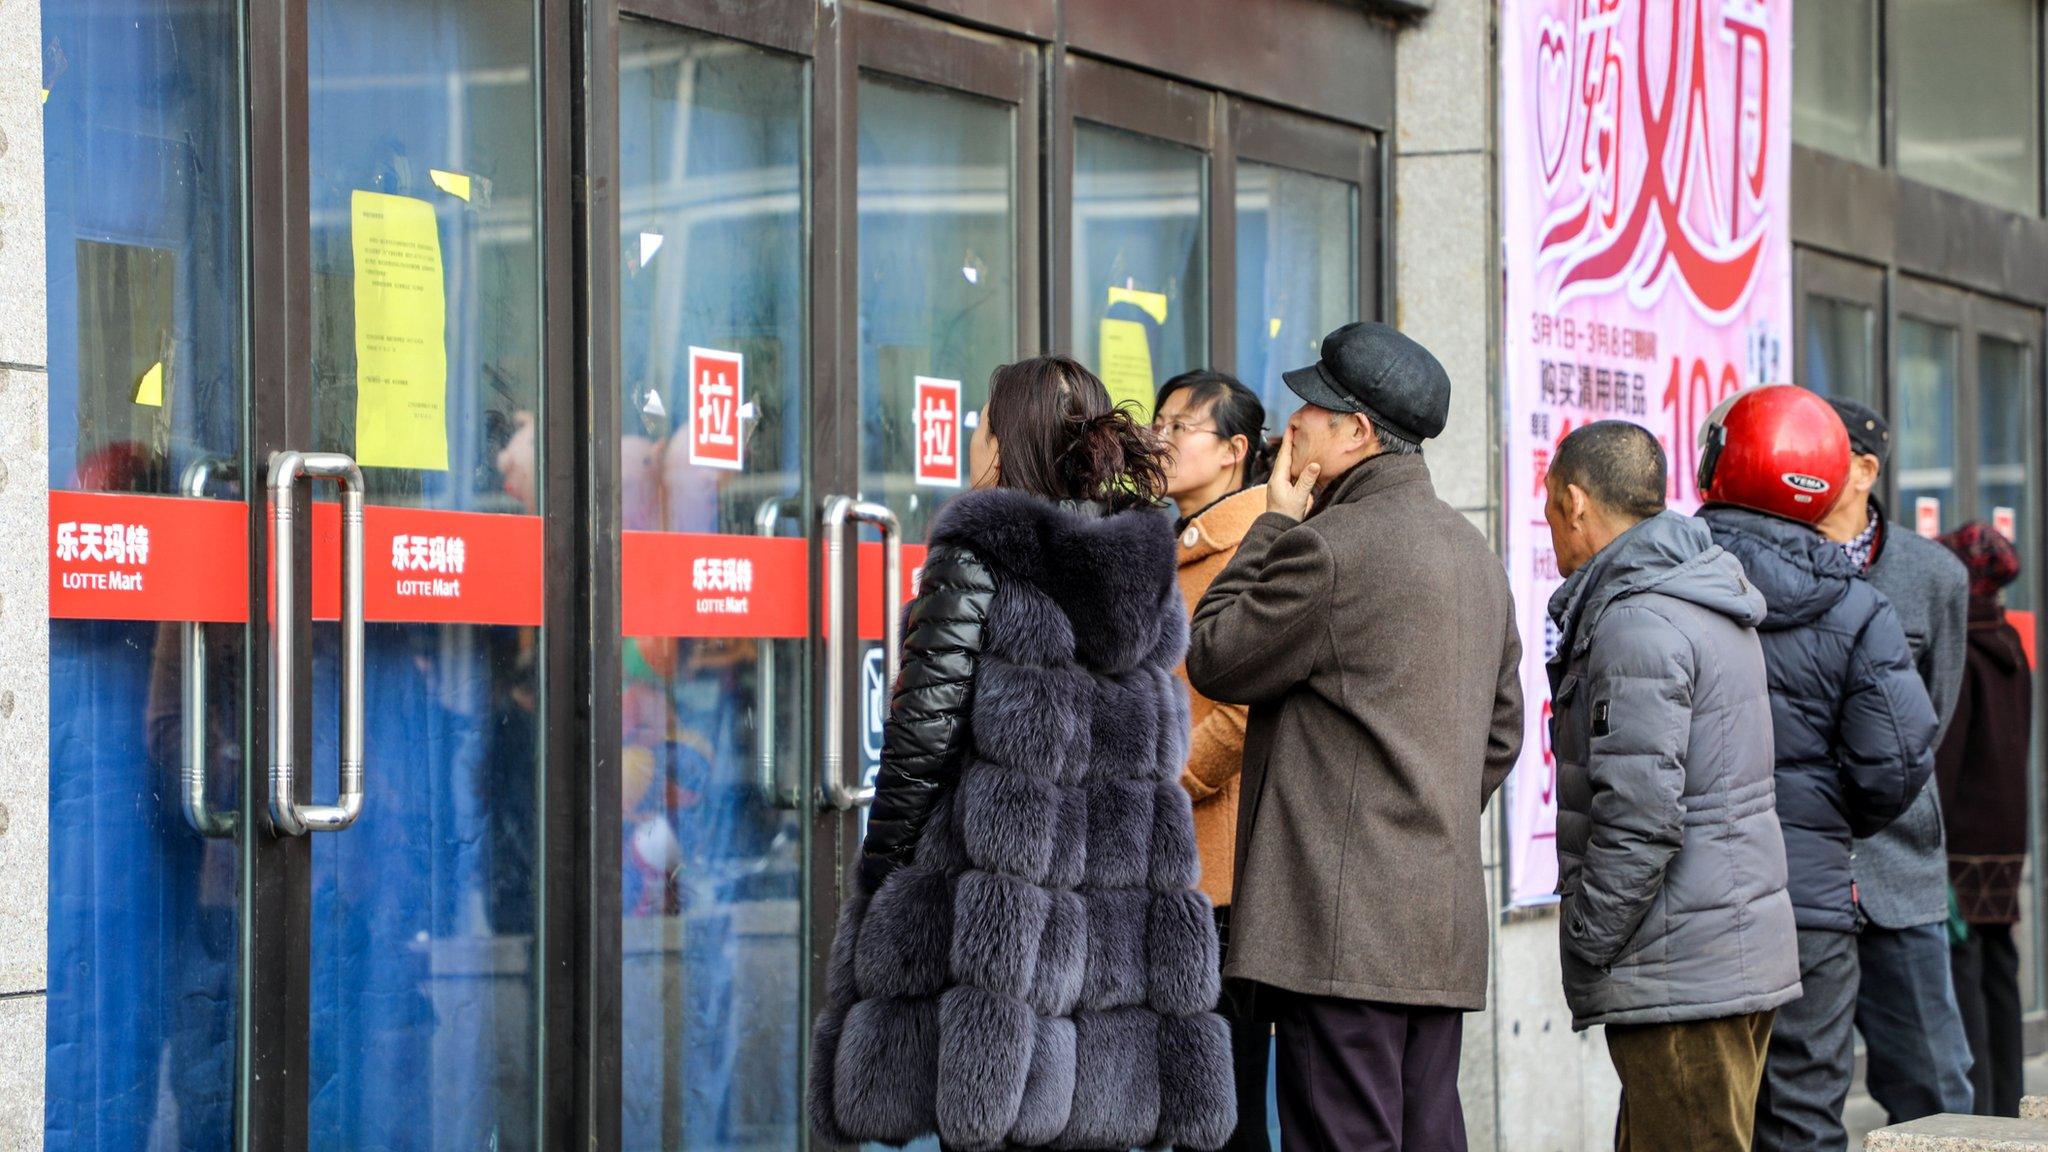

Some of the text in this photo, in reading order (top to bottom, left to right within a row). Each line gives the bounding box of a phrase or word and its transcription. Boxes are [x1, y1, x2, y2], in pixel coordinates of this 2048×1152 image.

[699, 369, 734, 445] 拉
[923, 396, 954, 466] 拉
[57, 522, 149, 564] 乐天玛特
[392, 534, 464, 573] 乐天玛特
[63, 571, 143, 590] LOTTE Mart
[397, 579, 459, 597] LOTTE Mart
[693, 558, 752, 592] 乐天玛特
[696, 597, 748, 614] LOTTE Mart
